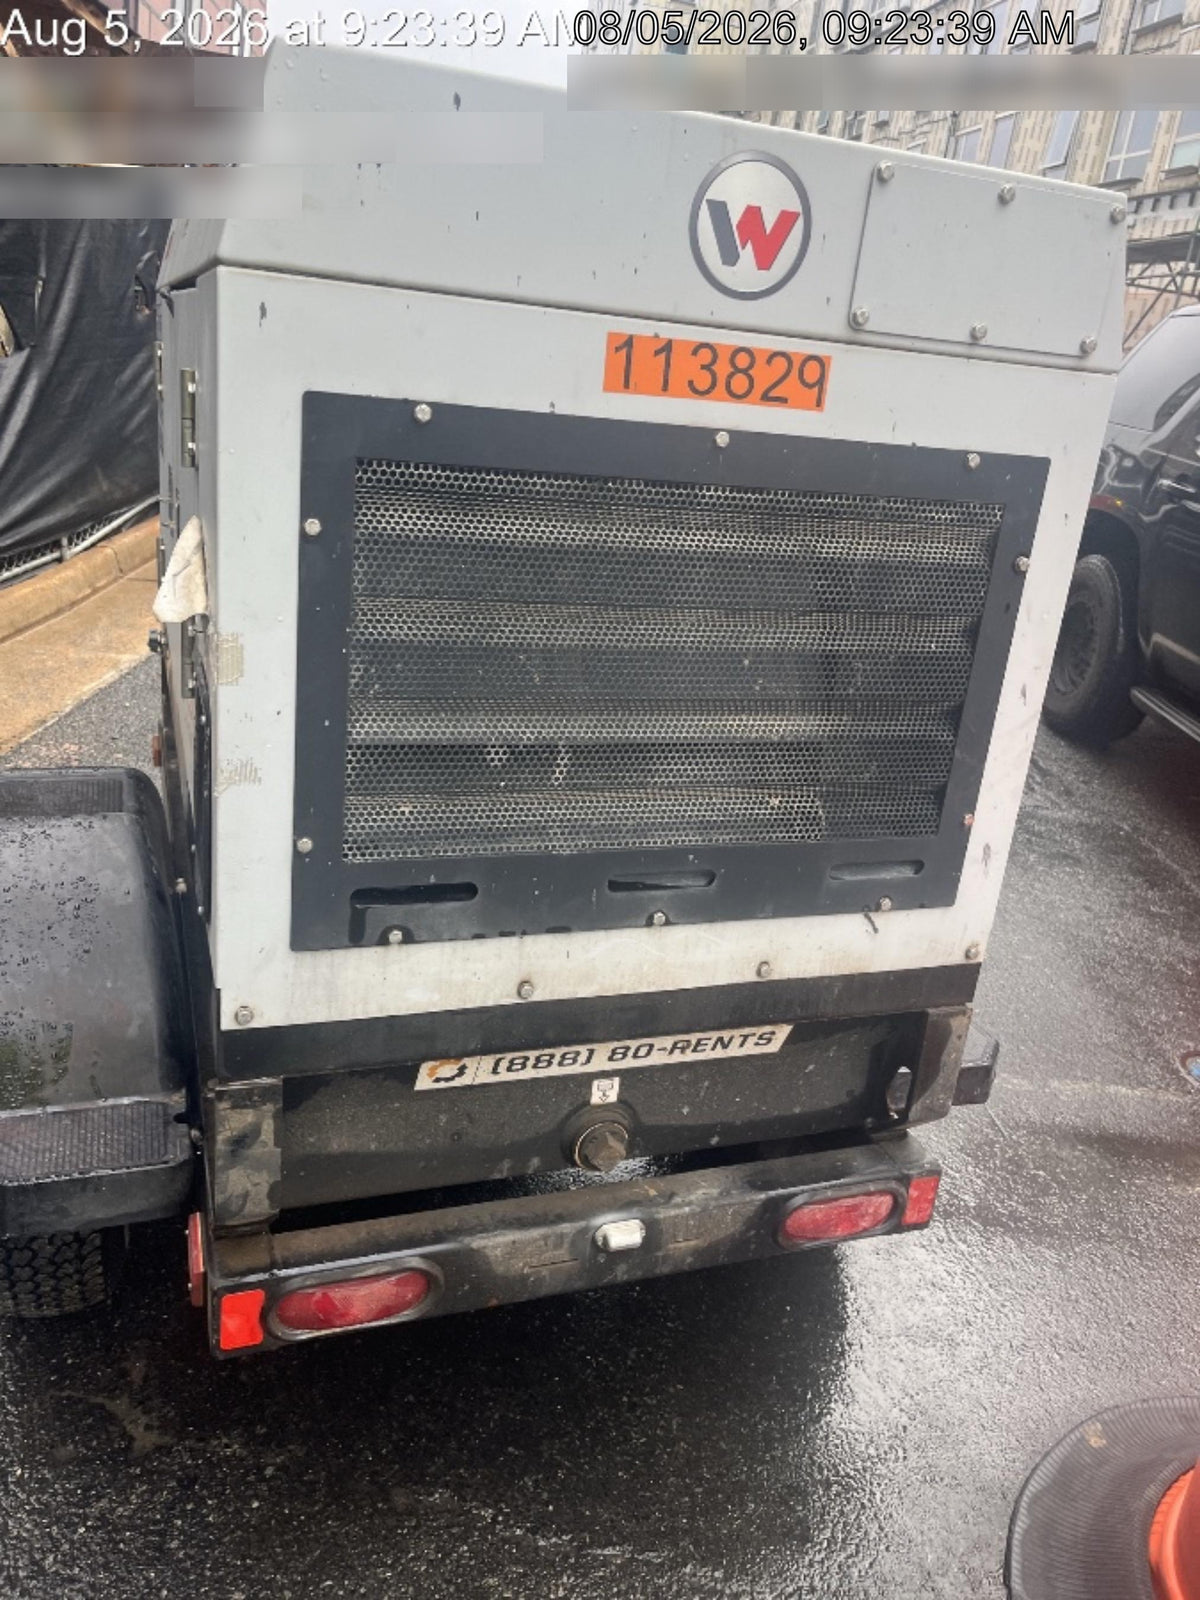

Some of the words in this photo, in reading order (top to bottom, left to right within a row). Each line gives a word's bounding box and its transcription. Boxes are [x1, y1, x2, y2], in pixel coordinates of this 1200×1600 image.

[705, 198, 801, 271] W
[614, 334, 826, 408] 113829
[607, 1030, 776, 1063] 80-RENTS
